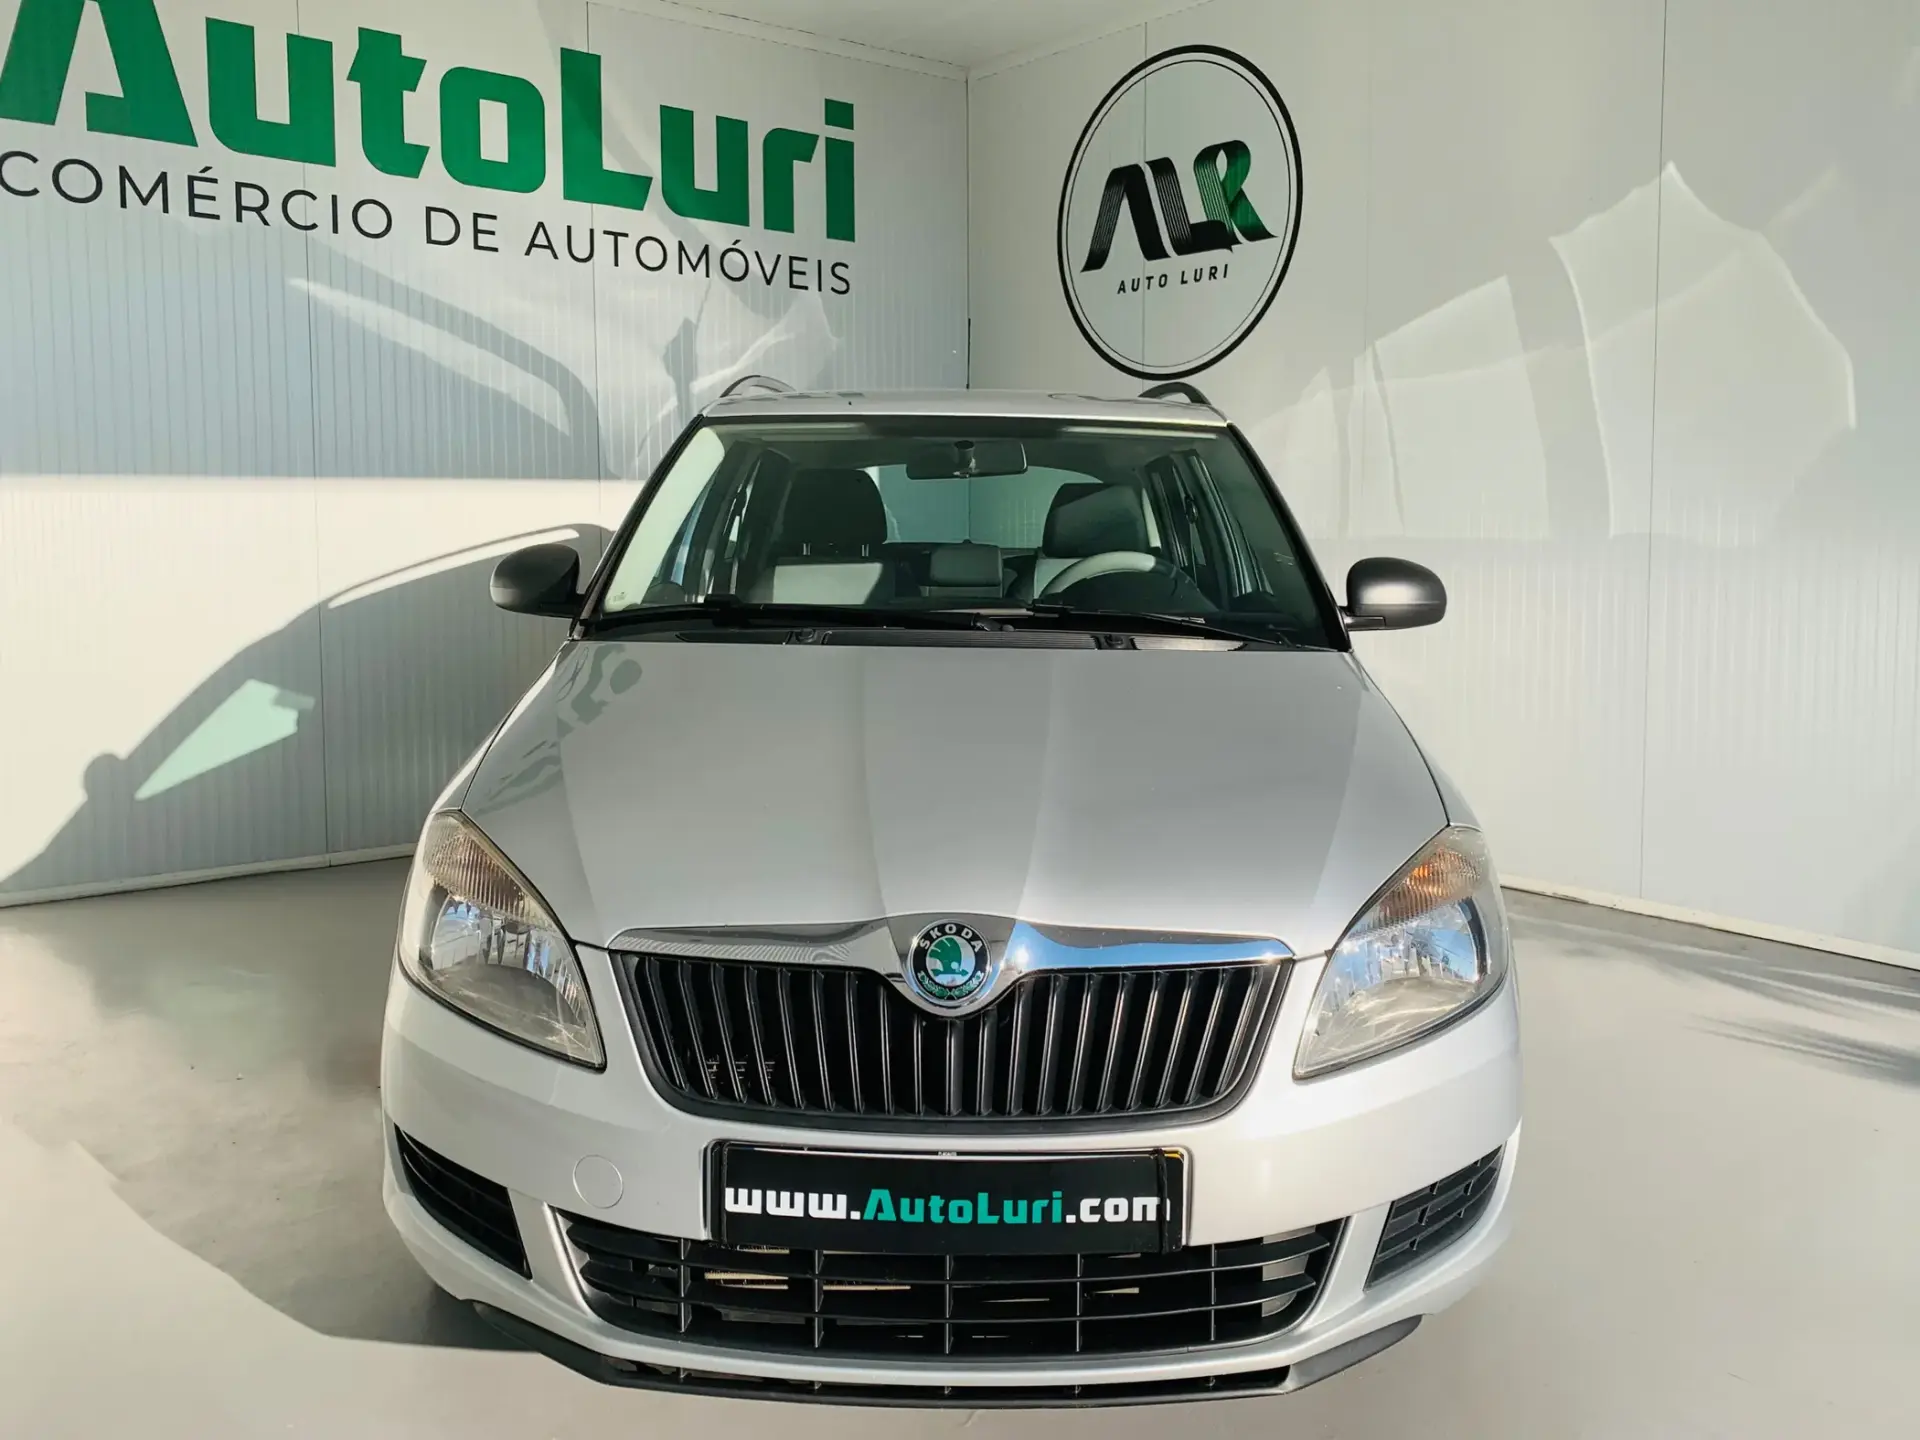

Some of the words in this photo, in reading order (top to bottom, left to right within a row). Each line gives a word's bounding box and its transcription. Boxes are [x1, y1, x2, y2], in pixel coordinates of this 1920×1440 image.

[0, 0, 855, 243] AutoLuri
[0, 150, 393, 239] COMÉRCIO
[425, 207, 499, 253] DE
[524, 221, 851, 296] AUTOMÓVEIS
[1117, 273, 1168, 294] AUTO
[1180, 263, 1229, 285] LURI
[919, 923, 983, 952] SKODA
[725, 1187, 1170, 1224] www.AutoLuri.com
